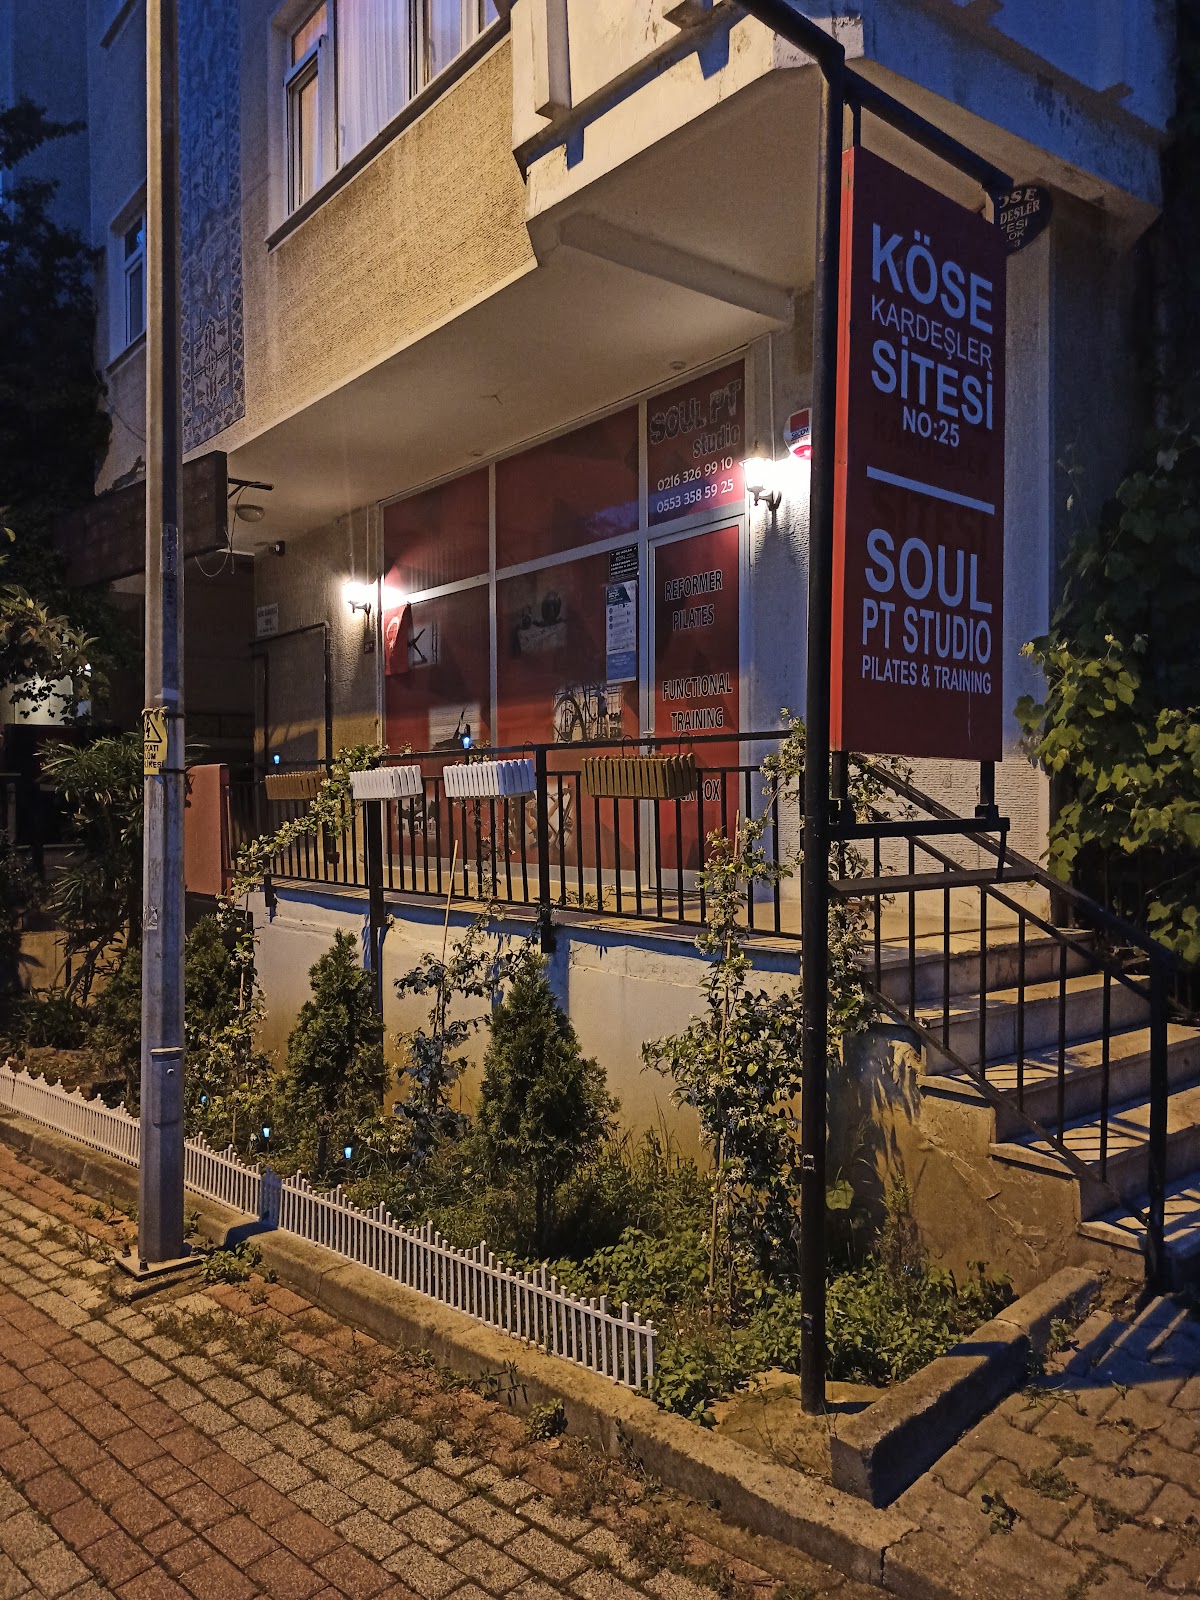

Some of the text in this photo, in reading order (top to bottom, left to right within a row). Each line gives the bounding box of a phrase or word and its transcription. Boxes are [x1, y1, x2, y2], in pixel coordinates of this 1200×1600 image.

[872, 223, 993, 334] KÖSE
[871, 294, 992, 369] KARDEŞLER
[871, 336, 993, 430] SİTESİ
[650, 379, 742, 445] SOUL PT
[902, 406, 960, 448] NO:25
[693, 422, 741, 459] studio
[657, 456, 734, 492] 0216 326 99 10
[656, 478, 735, 513] 0553 358 59 25
[664, 568, 723, 602] REFORMER
[864, 528, 993, 613] SOUL
[672, 604, 715, 632] PILATES
[862, 597, 992, 665] PT STUDIO
[662, 672, 733, 702] FUNCTIONAL
[862, 654, 992, 695] PILATES & TRAINING
[670, 706, 724, 732] TRAINING
[696, 779, 721, 801] OX
